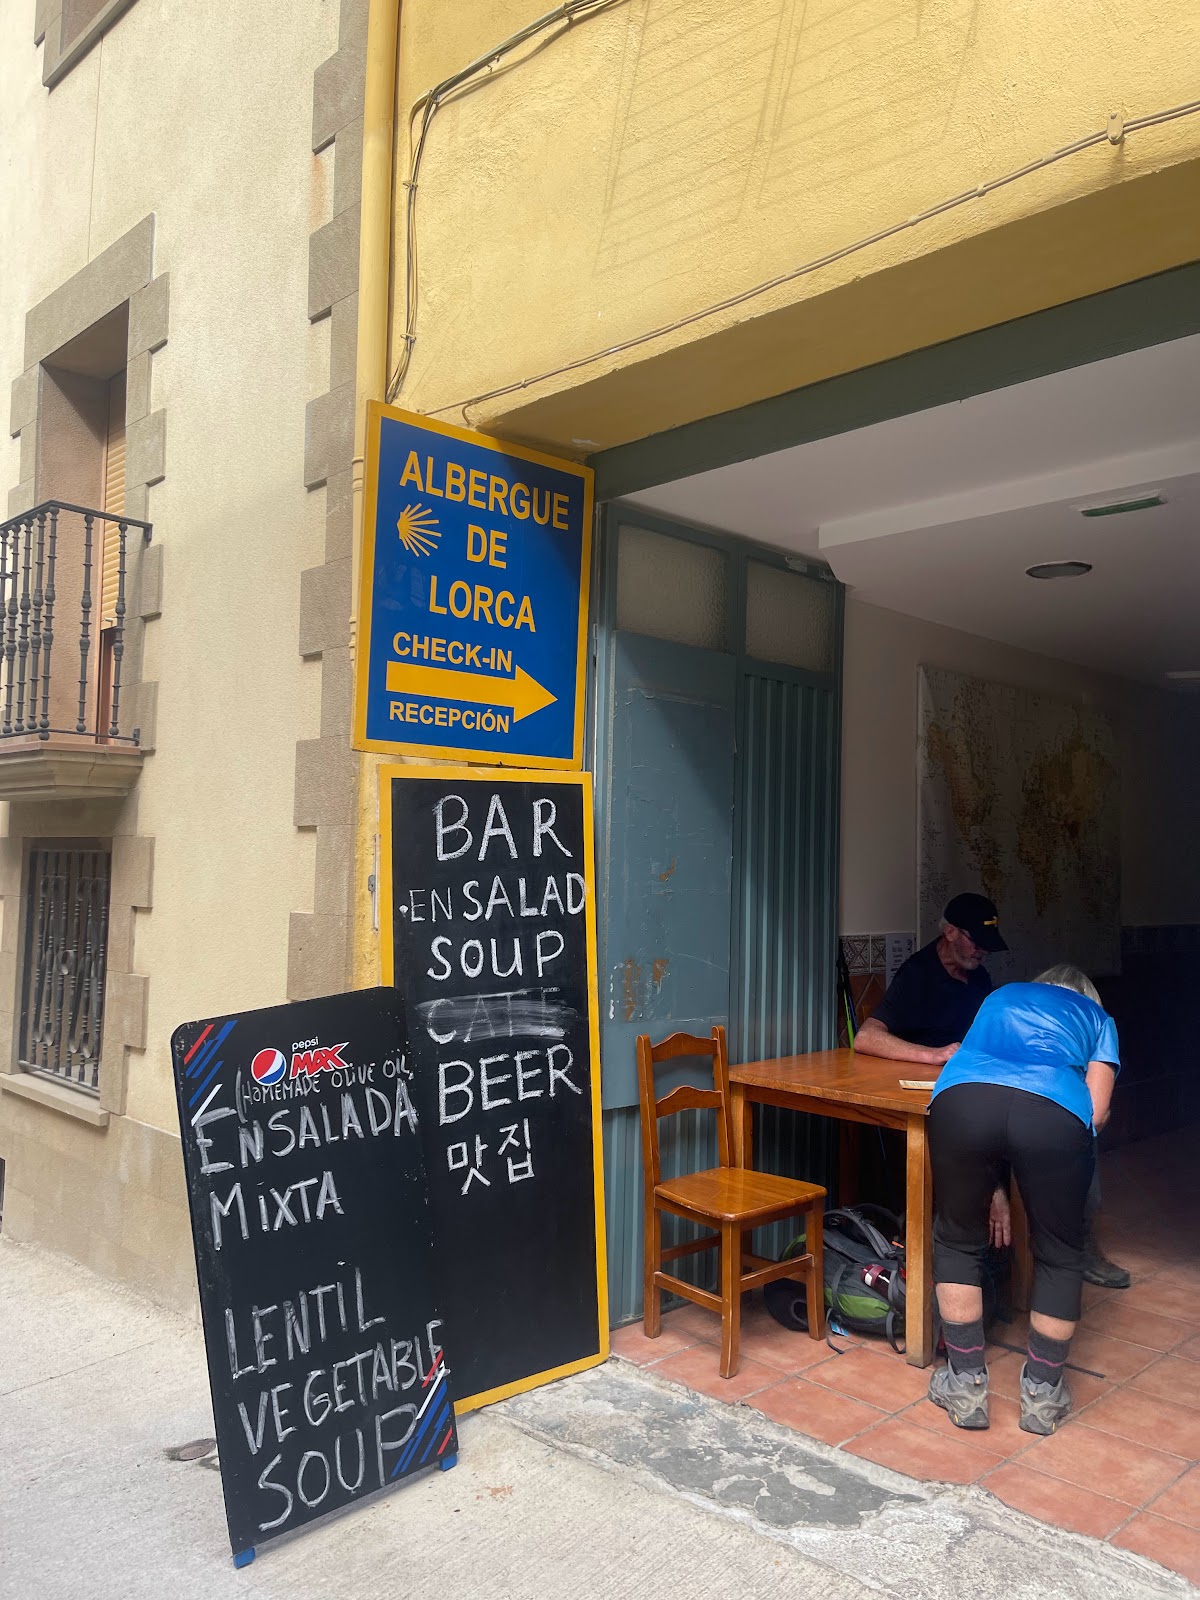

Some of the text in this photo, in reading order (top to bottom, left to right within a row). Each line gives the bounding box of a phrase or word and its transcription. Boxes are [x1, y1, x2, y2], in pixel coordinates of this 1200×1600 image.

[399, 450, 570, 531] ALBERGUE
[466, 524, 508, 569] DE
[428, 575, 536, 633] LORCA
[392, 631, 513, 673] CHECK-IN
[389, 700, 510, 734] RECEPCIÓN
[433, 793, 574, 862] BAR
[427, 930, 565, 981] SOUP
[289, 1042, 351, 1080] MAX
[291, 1036, 320, 1052] pepsi
[438, 1043, 583, 1126] BEER
[194, 1077, 420, 1176] ENSALADA
[446, 1117, 535, 1196] 맛집
[237, 1319, 451, 1455] VEGETABLE
[257, 1402, 418, 1532] SOUP
